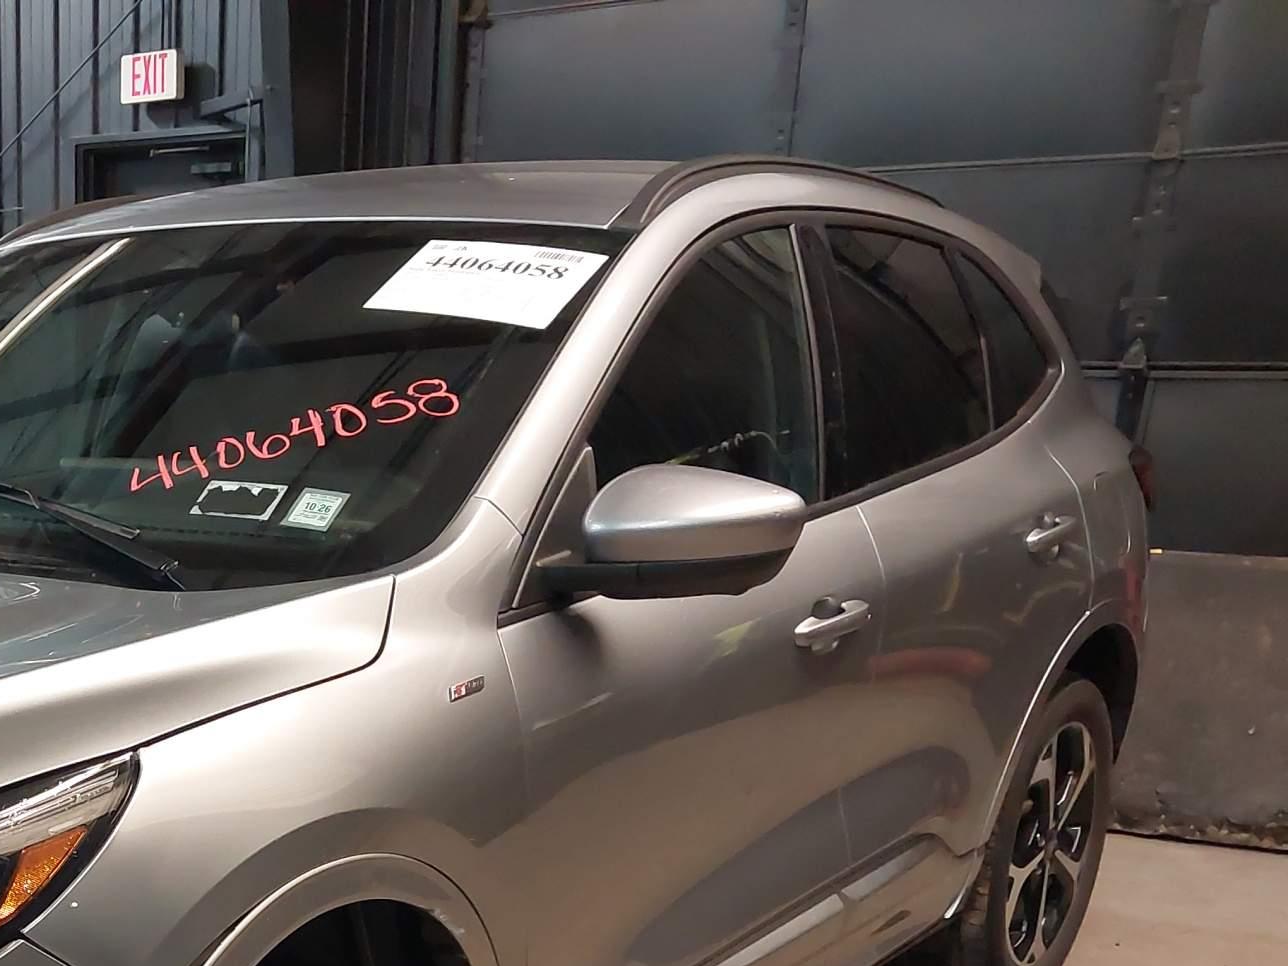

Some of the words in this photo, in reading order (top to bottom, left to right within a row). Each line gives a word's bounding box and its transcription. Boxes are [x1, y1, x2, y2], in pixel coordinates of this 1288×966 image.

[132, 53, 168, 96] EXIT
[425, 255, 569, 280] 44064058
[130, 379, 460, 492] 44064058
